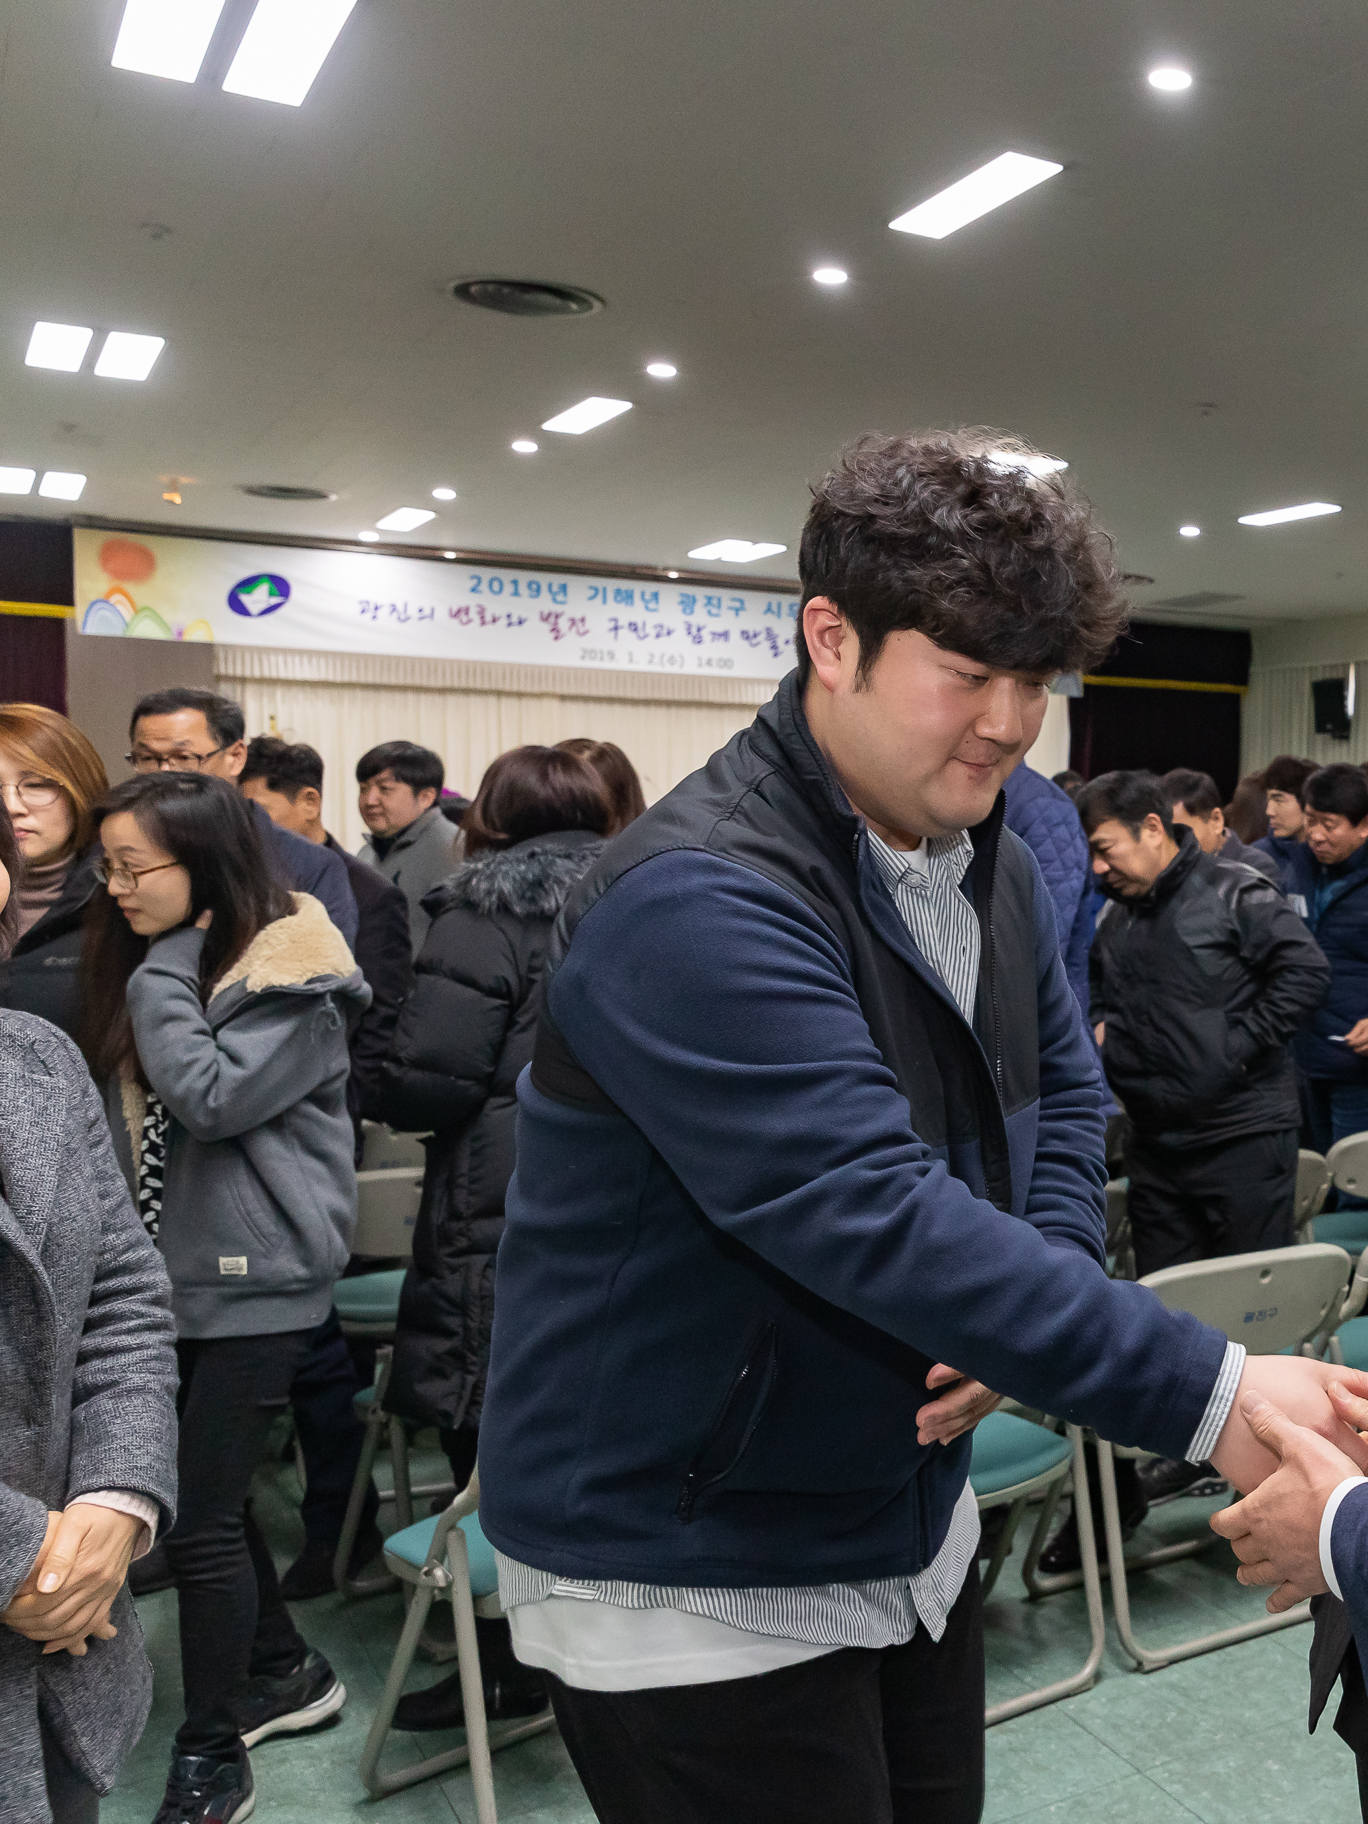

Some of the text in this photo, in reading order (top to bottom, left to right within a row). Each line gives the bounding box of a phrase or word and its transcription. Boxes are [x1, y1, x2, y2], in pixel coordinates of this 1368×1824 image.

[469, 574, 568, 605] 2019년
[587, 585, 661, 613] 기해년
[678, 592, 747, 618] 광진구
[448, 603, 528, 628] 변화와
[539, 609, 591, 642] 발전
[608, 616, 677, 642] 구민과
[684, 620, 731, 645] 함께
